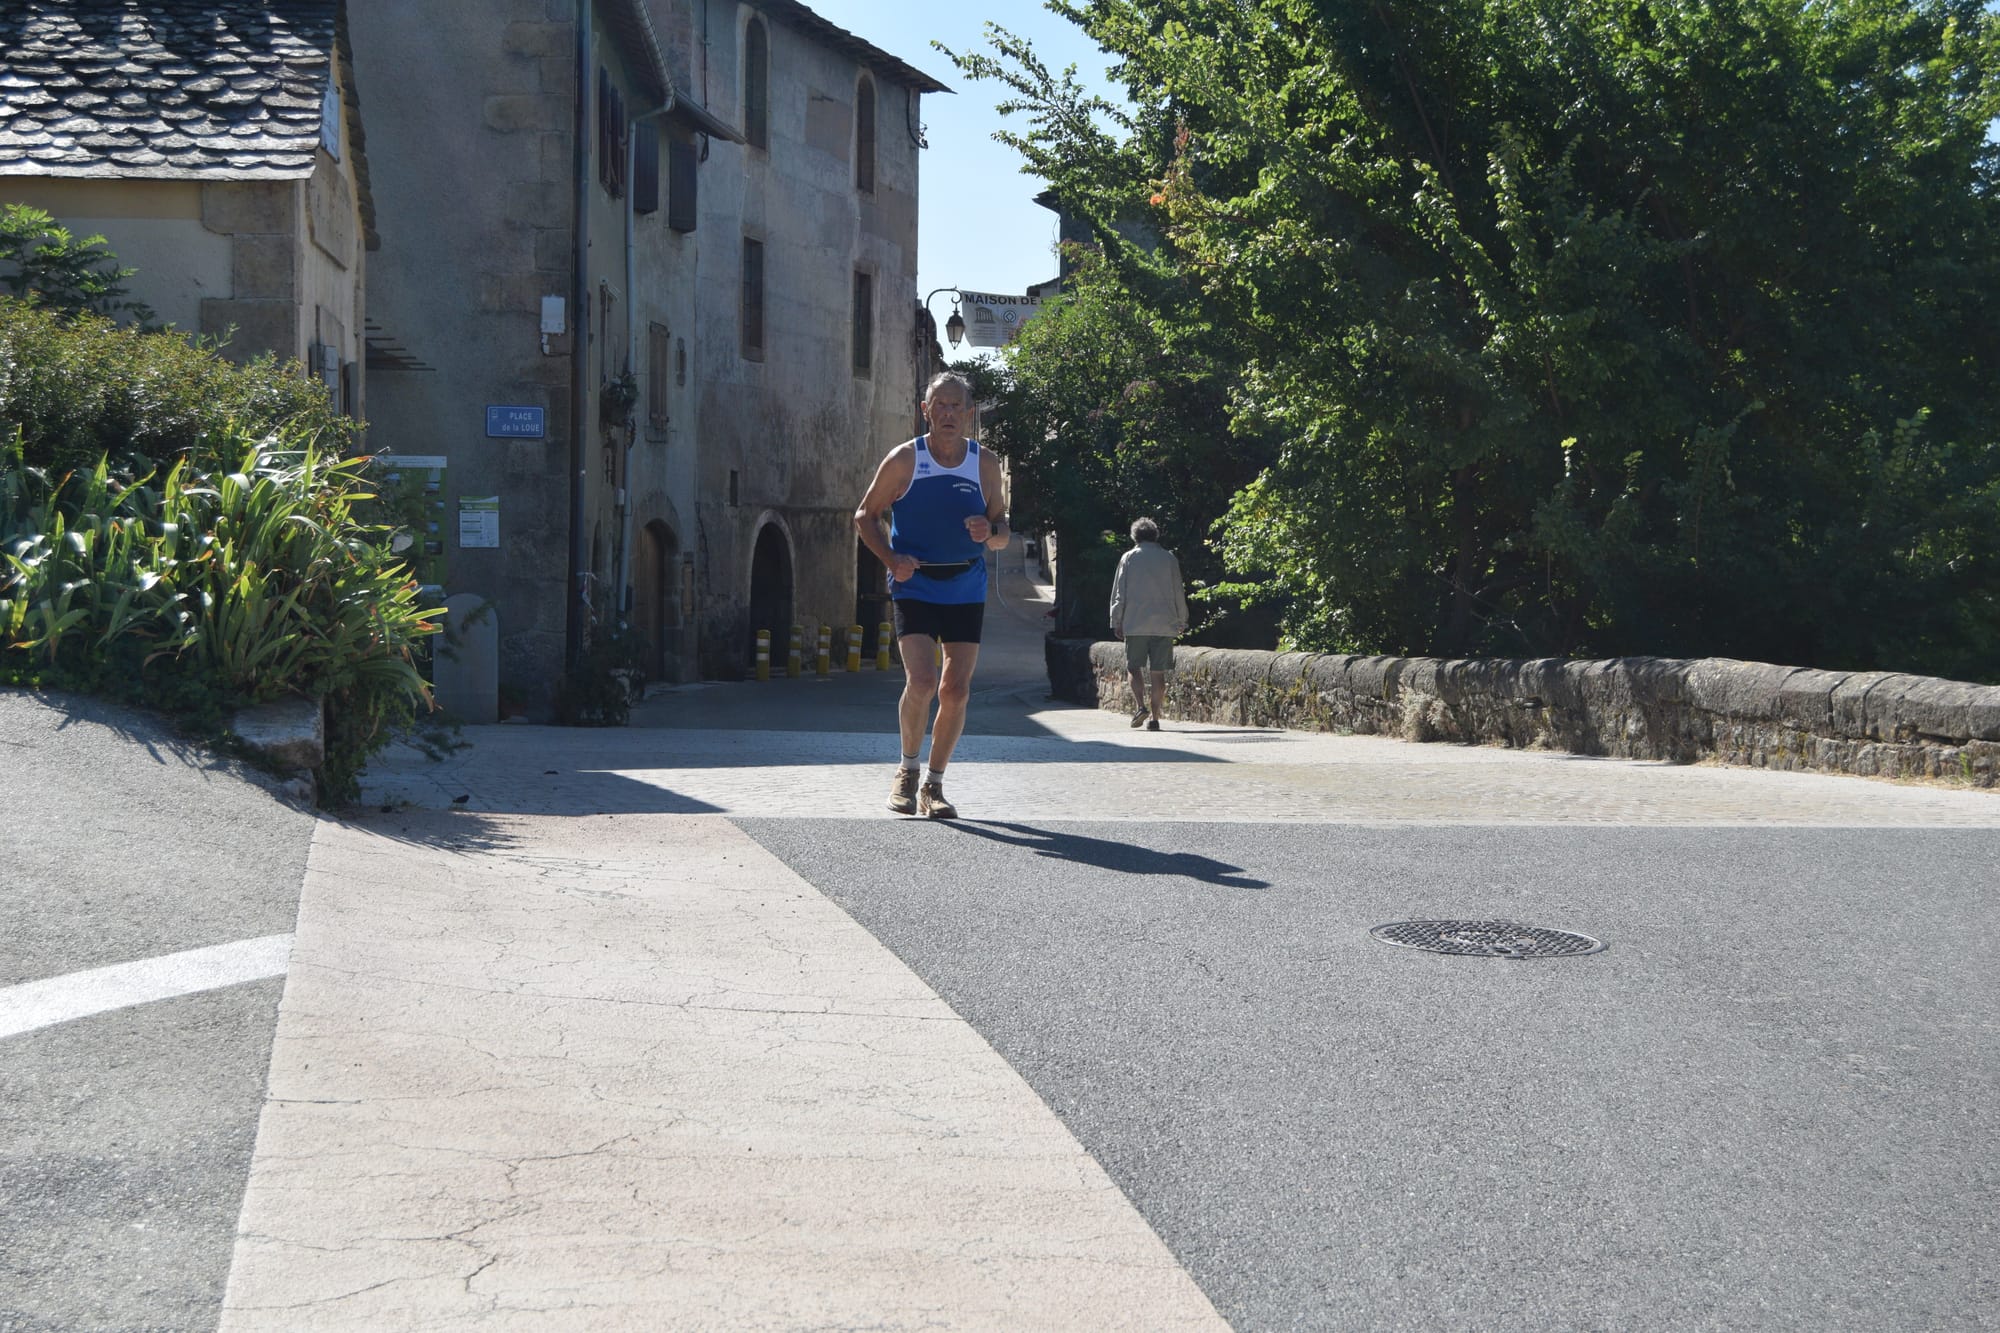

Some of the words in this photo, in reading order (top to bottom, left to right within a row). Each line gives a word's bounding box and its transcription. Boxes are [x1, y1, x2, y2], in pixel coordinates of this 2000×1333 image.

[965, 294, 1016, 305] MAISON
[1021, 296, 1037, 305] DE
[509, 412, 532, 420] PLACE
[502, 423, 511, 431] de
[512, 423, 519, 431] la
[521, 423, 540, 432] LOUE
